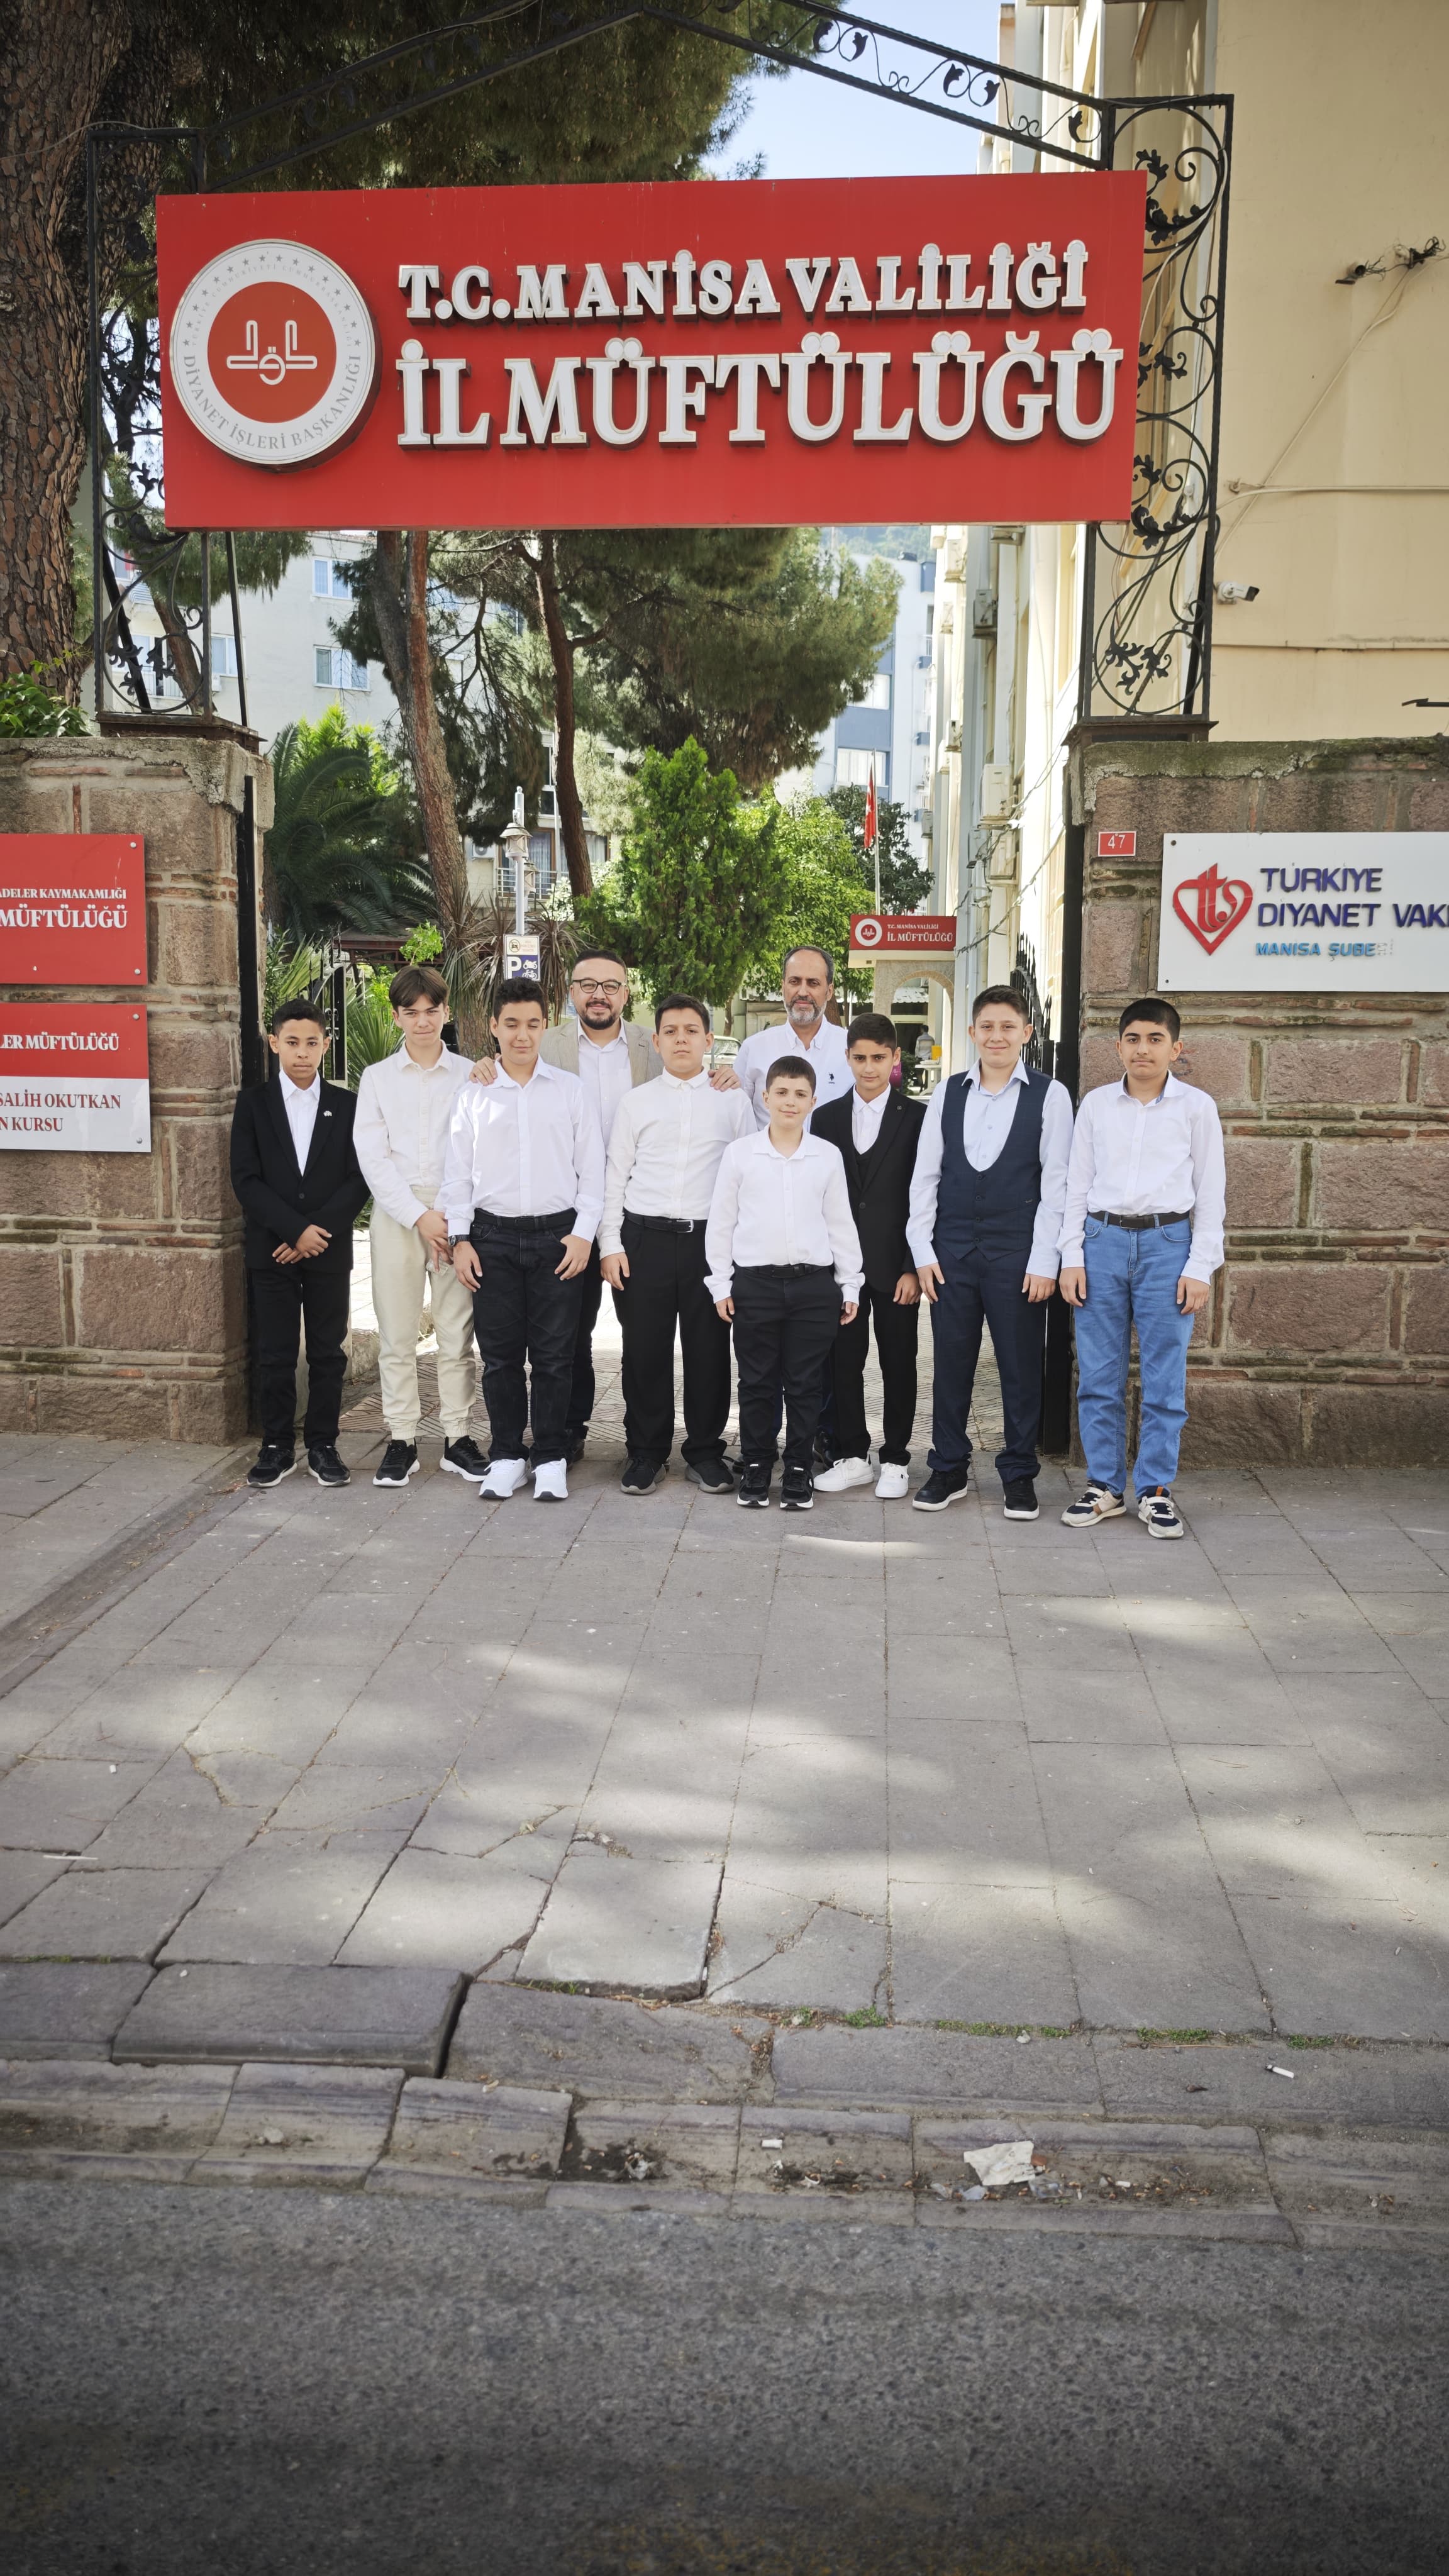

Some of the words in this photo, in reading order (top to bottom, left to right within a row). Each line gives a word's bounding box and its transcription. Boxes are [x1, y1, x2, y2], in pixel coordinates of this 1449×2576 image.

[786, 240, 1088, 313] VALİLİĞİ
[396, 339, 490, 445] İL
[500, 328, 1123, 444] MÜFTÜLÜĞÜ
[183, 355, 229, 430] DİYANET
[229, 423, 287, 449] İŞLERİ
[291, 355, 361, 446] BAŞKANLIĞI
[1108, 835, 1125, 849] 47
[0, 888, 38, 898] DELER
[40, 887, 126, 899] KAYMAKAMLIĞI
[0, 903, 128, 928] MÜFTÜLÜĞÜ
[887, 931, 896, 941] İL
[897, 931, 953, 942] MÜFTÜLÜĞÜ
[508, 957, 521, 979] P
[25, 1031, 119, 1051] MÜFTÜLÜĞÜ
[45, 1093, 121, 1109] OKUTKAN
[12, 1117, 64, 1131] KURSU
